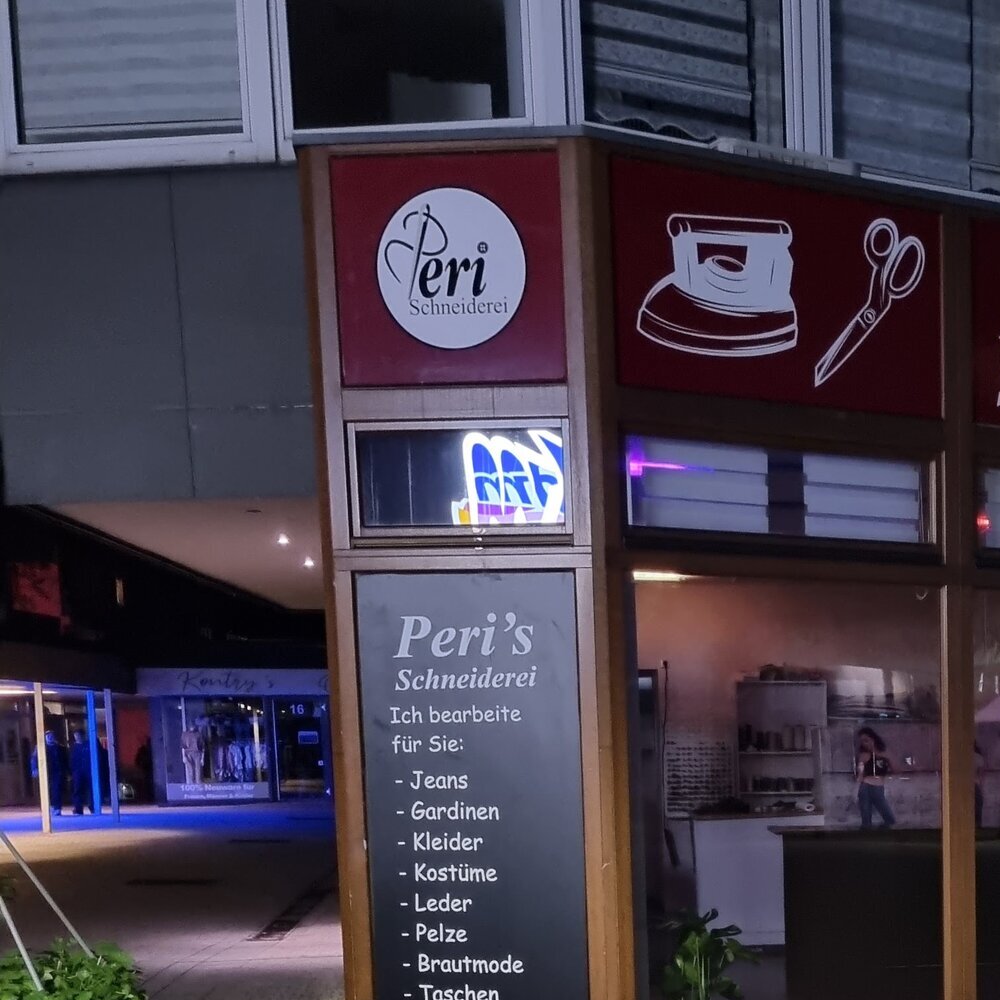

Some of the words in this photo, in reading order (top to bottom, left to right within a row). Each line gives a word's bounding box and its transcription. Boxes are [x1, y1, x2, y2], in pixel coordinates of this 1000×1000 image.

[384, 203, 489, 300] Peri
[409, 296, 509, 316] Schneiderei
[392, 611, 534, 659] Peri's
[394, 665, 538, 691] Schneiderei
[289, 704, 305, 715] 16
[389, 706, 423, 724] Ich
[429, 705, 522, 723] bearbeite
[391, 735, 422, 754] für
[428, 735, 465, 753] Sie:
[410, 770, 468, 790] Jeans
[411, 801, 500, 821] Gardinen
[413, 831, 483, 851] Kleider
[415, 862, 498, 882] Kostüme
[415, 893, 472, 912] Leder
[415, 923, 468, 943] Pelze
[418, 953, 525, 974] Brautmode
